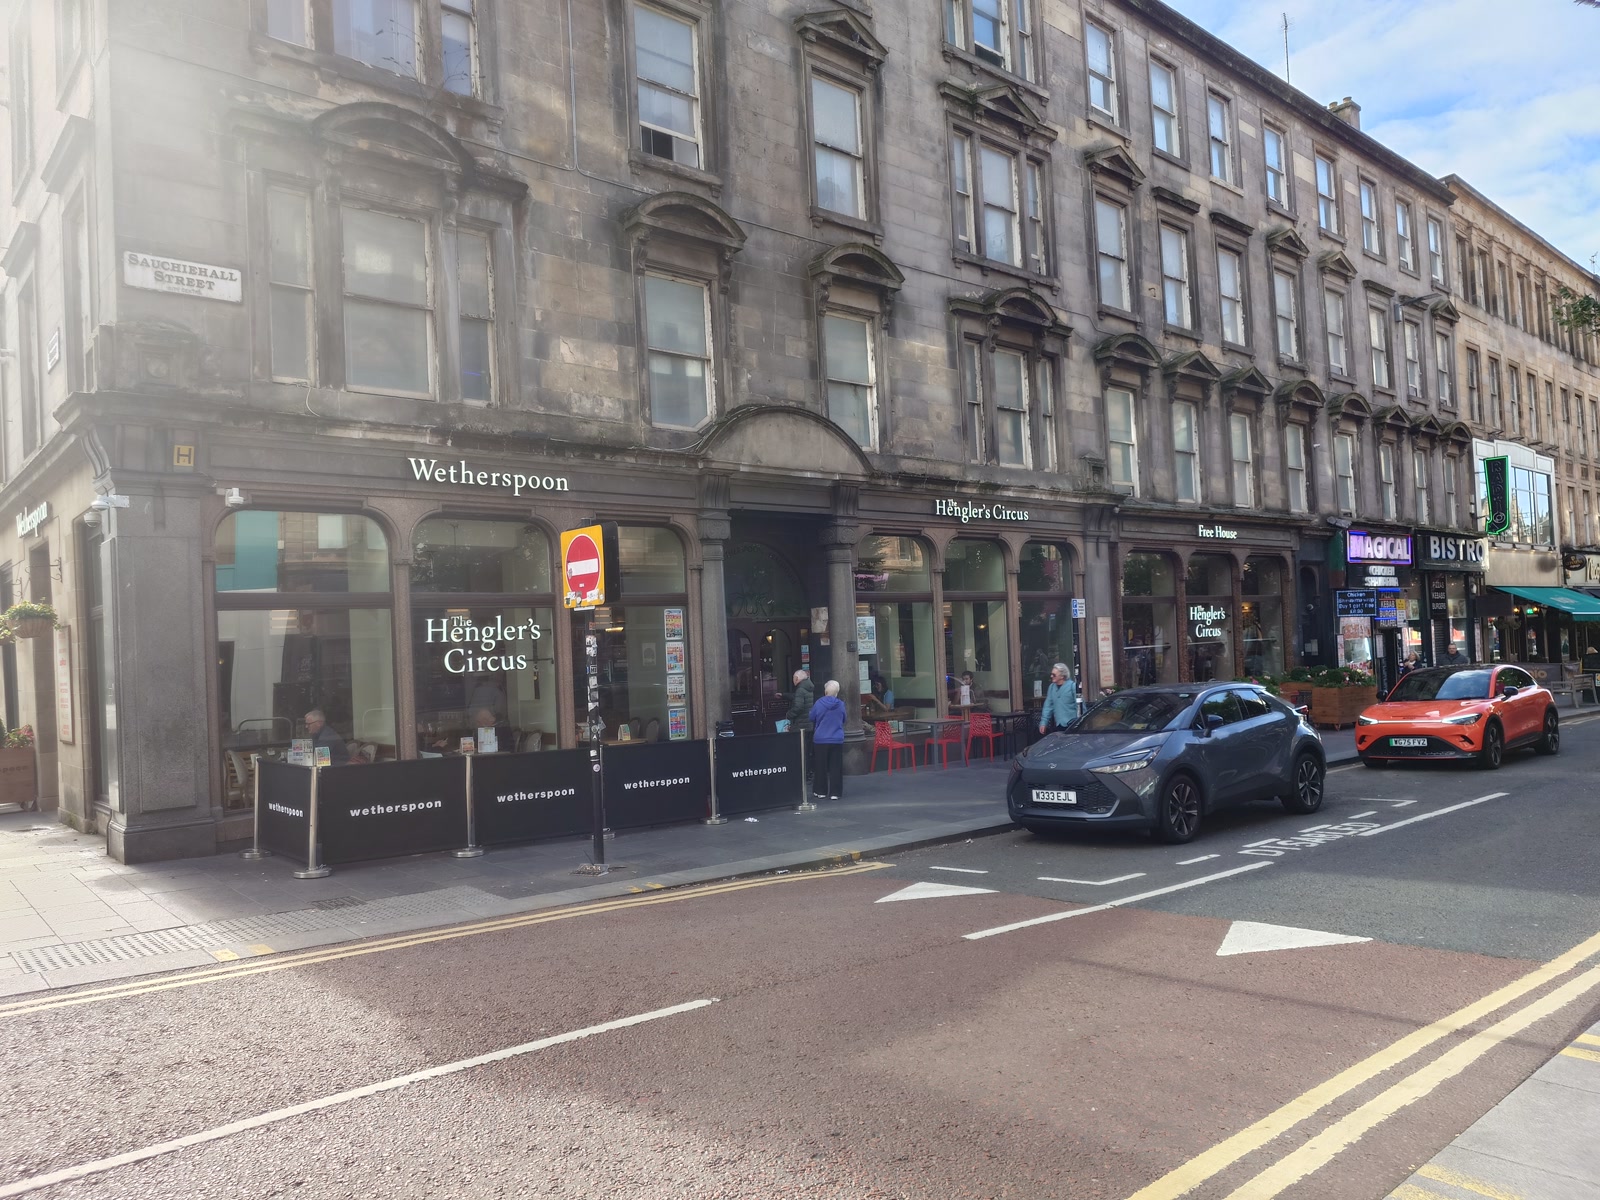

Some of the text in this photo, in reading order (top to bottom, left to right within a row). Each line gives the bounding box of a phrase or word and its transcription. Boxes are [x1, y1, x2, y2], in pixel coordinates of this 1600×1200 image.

[127, 253, 238, 282] SAUCHIEHALL
[154, 270, 215, 290] STREET
[408, 457, 569, 496] Wetherspoon
[935, 499, 1029, 523] Hengler's Circus
[947, 498, 958, 507] The
[1198, 524, 1238, 539] Free House
[1349, 534, 1411, 560] MAGICAL
[1430, 536, 1486, 562] BISTRO
[450, 616, 472, 627] The
[1190, 605, 1226, 626] Hengler's
[425, 615, 541, 651] Hengler's
[1195, 623, 1222, 638] Circus
[444, 649, 528, 674] Circus
[731, 765, 788, 779] wetherspoon
[623, 776, 691, 790] wetherspoon
[496, 786, 576, 803] wetherspoon
[1056, 791, 1073, 802] EJL
[268, 802, 304, 818] wetherspoon
[349, 799, 442, 817] wetherspoon
[1237, 822, 1381, 857] DISABLED
